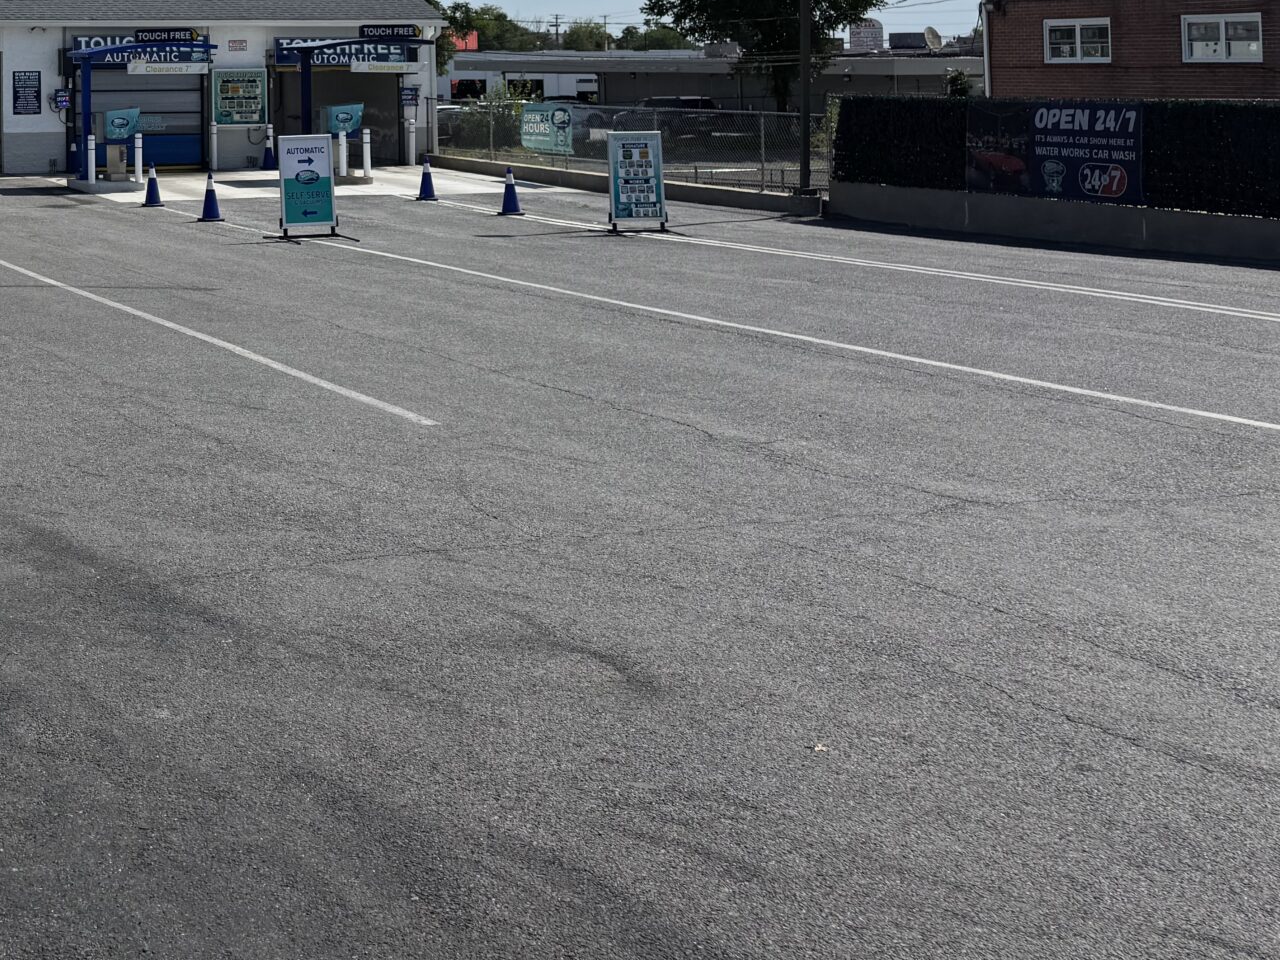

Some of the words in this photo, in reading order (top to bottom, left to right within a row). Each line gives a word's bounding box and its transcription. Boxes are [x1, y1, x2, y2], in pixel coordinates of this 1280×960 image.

[363, 27, 393, 35] TOUCH
[394, 27, 414, 35] FREE
[137, 31, 168, 41] TOUCH
[170, 31, 192, 40] FREE
[310, 54, 377, 63] UTOMATIC
[145, 65, 183, 73] Clearance
[523, 114, 540, 122] OPEN
[540, 113, 550, 122] 24
[1034, 107, 1090, 130] OPEN
[1094, 108, 1137, 132] 24/7
[523, 123, 550, 133] HOURS
[1035, 134, 1045, 142] IT'S
[1046, 135, 1068, 143] ALWAYS
[1075, 136, 1088, 144] CAR
[1089, 137, 1108, 145] SHOW
[1108, 138, 1125, 146] HERE
[286, 147, 325, 155] AUTOMATIC
[1035, 146, 1059, 157] WATER
[1060, 148, 1090, 158] WORKS
[1092, 149, 1109, 159] CAR
[1111, 150, 1136, 161] WASH
[1084, 168, 1101, 190] 24
[1110, 170, 1121, 191] 7
[306, 191, 330, 199] SERVE
